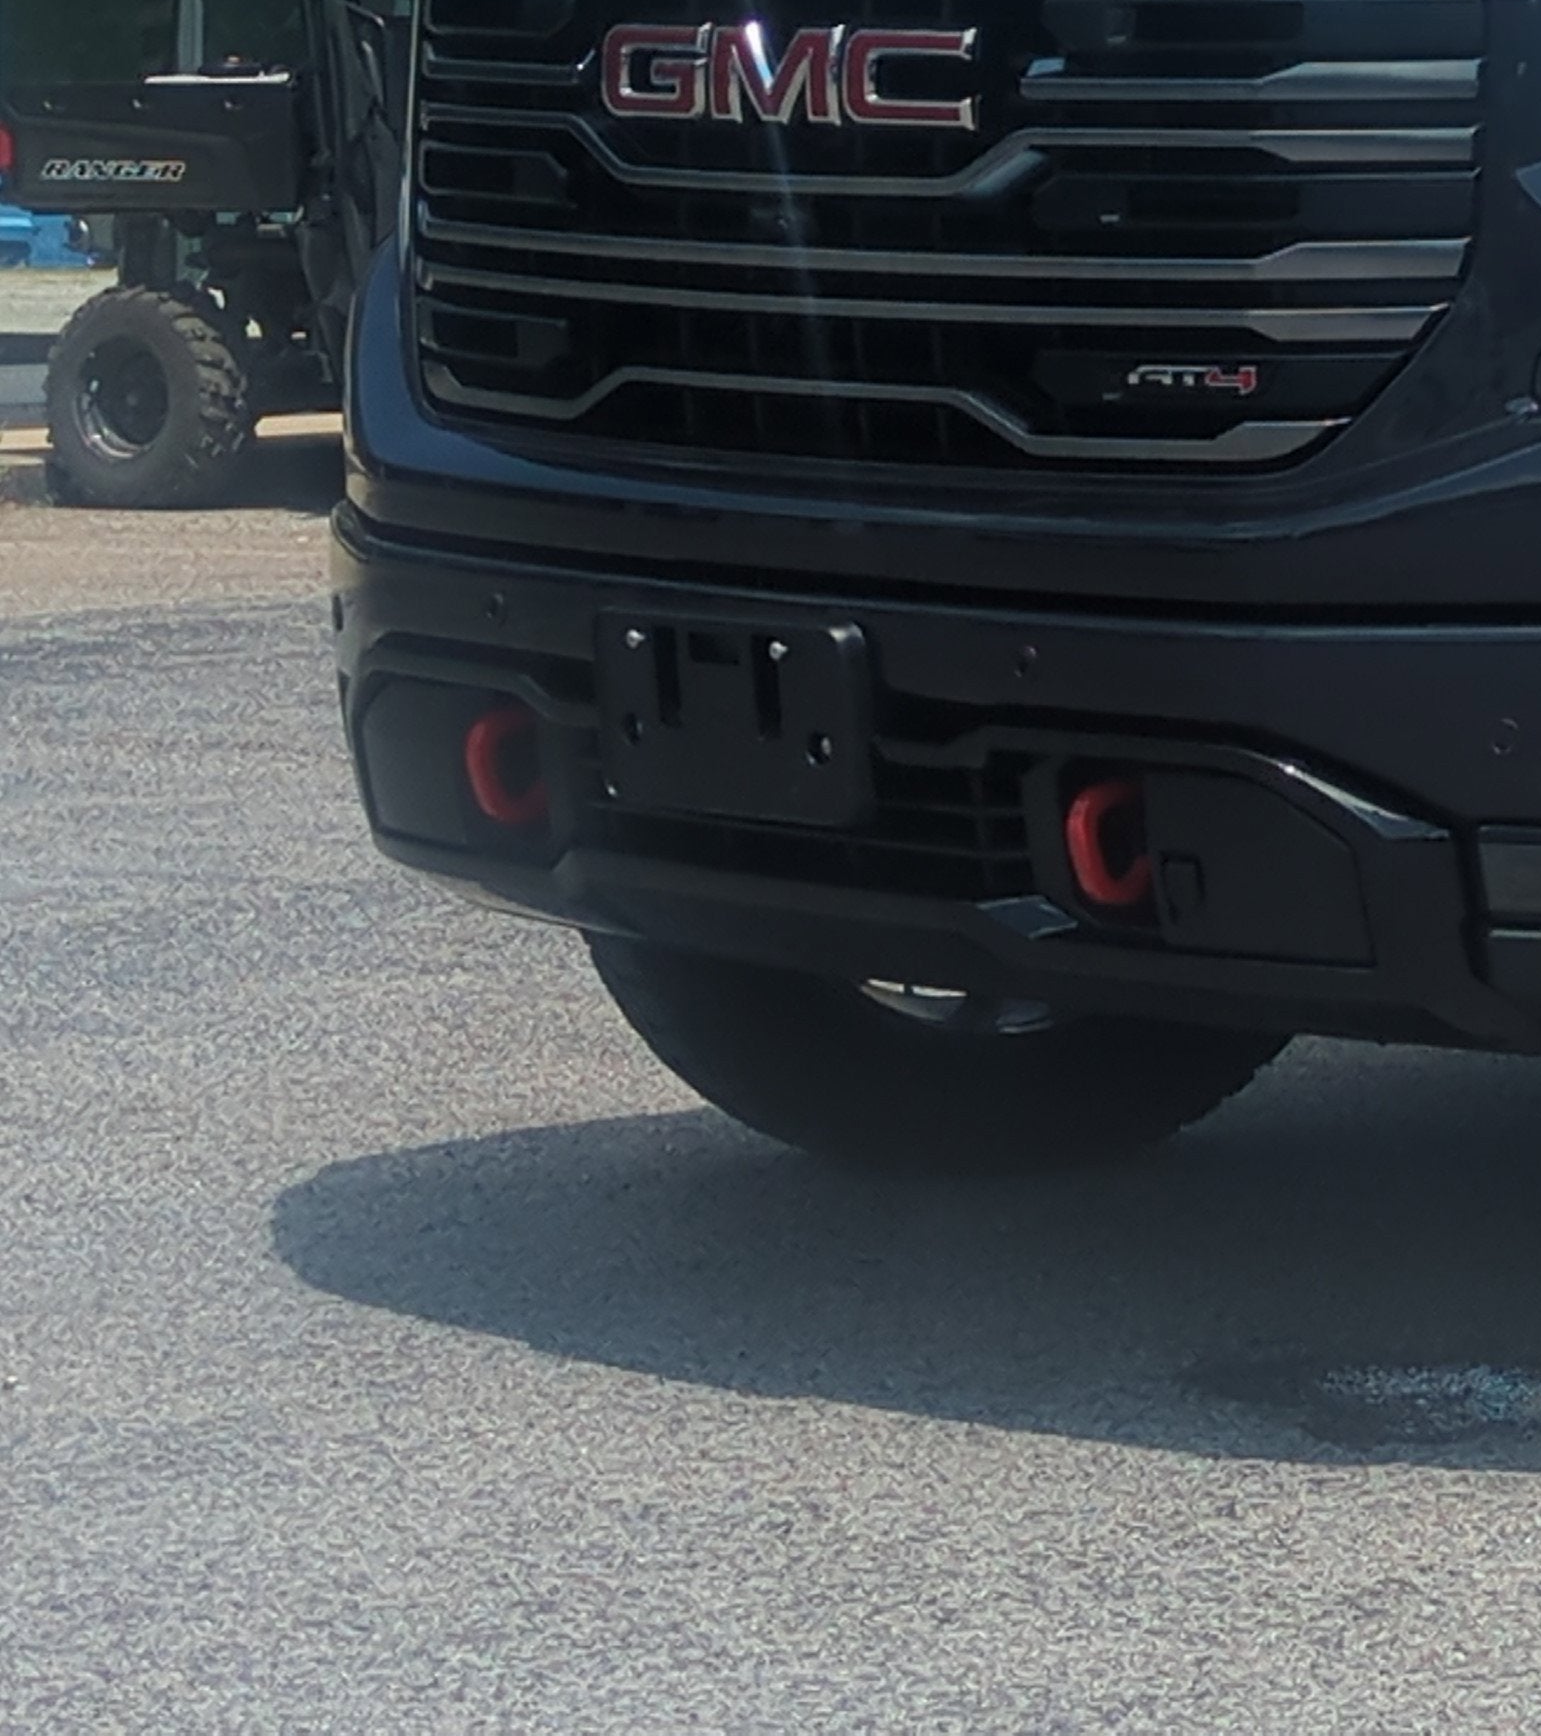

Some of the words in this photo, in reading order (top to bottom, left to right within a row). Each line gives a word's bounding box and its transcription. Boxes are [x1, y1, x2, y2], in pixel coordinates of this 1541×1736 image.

[602, 21, 982, 130] GMC
[41, 158, 186, 183] RANGER
[1126, 363, 1259, 396] AT4
